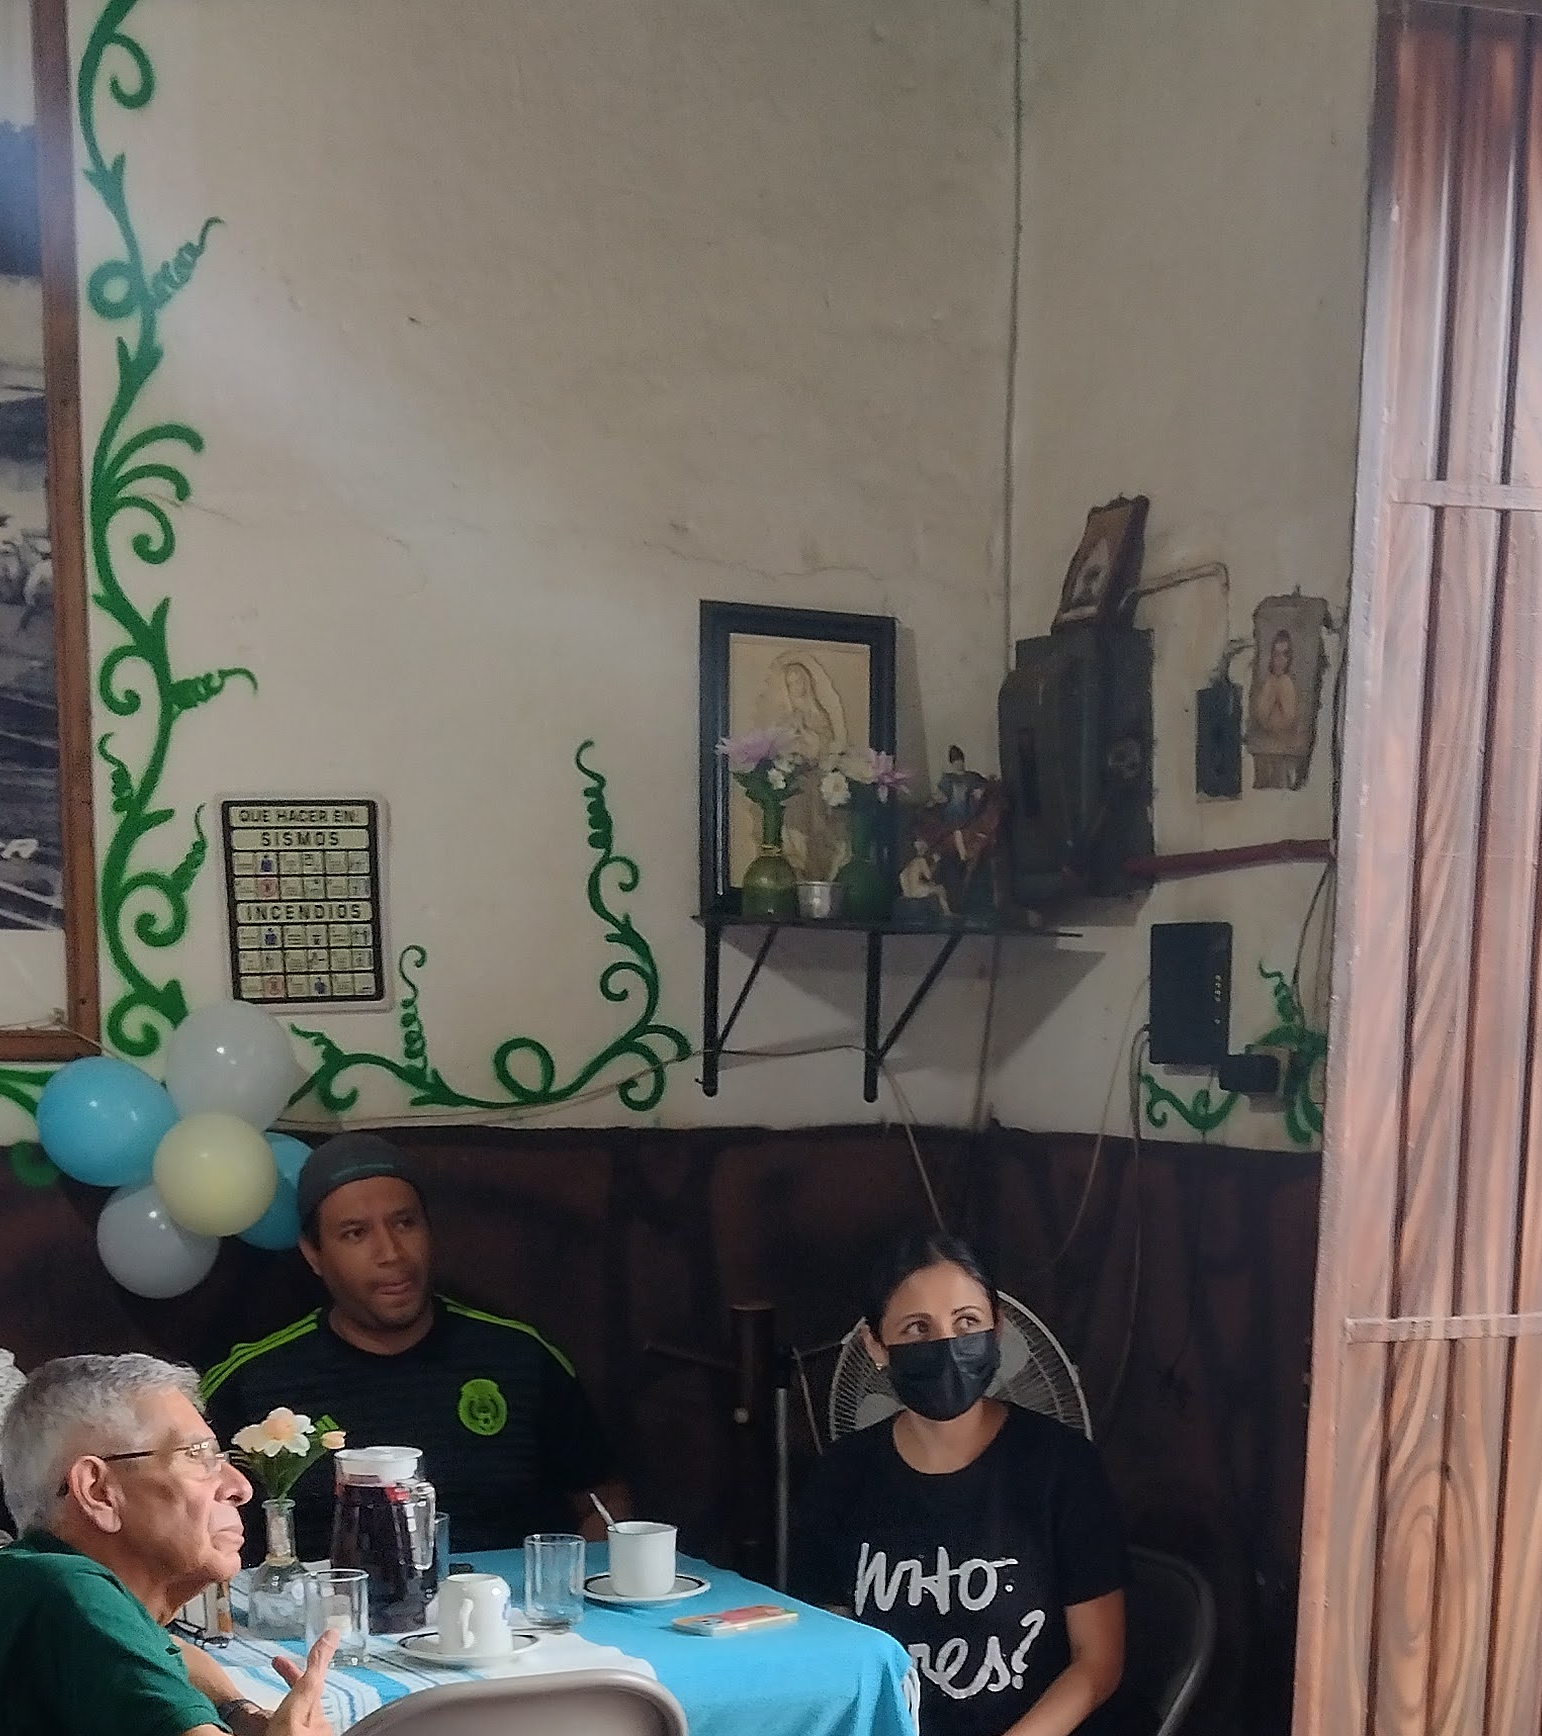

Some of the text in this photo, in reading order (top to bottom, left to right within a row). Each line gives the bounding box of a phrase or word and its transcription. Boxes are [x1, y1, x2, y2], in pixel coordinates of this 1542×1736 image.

[239, 808, 270, 823] QUE
[277, 808, 328, 823] HACER
[261, 831, 339, 847] SISMOS
[246, 903, 362, 921] INCENDIOS
